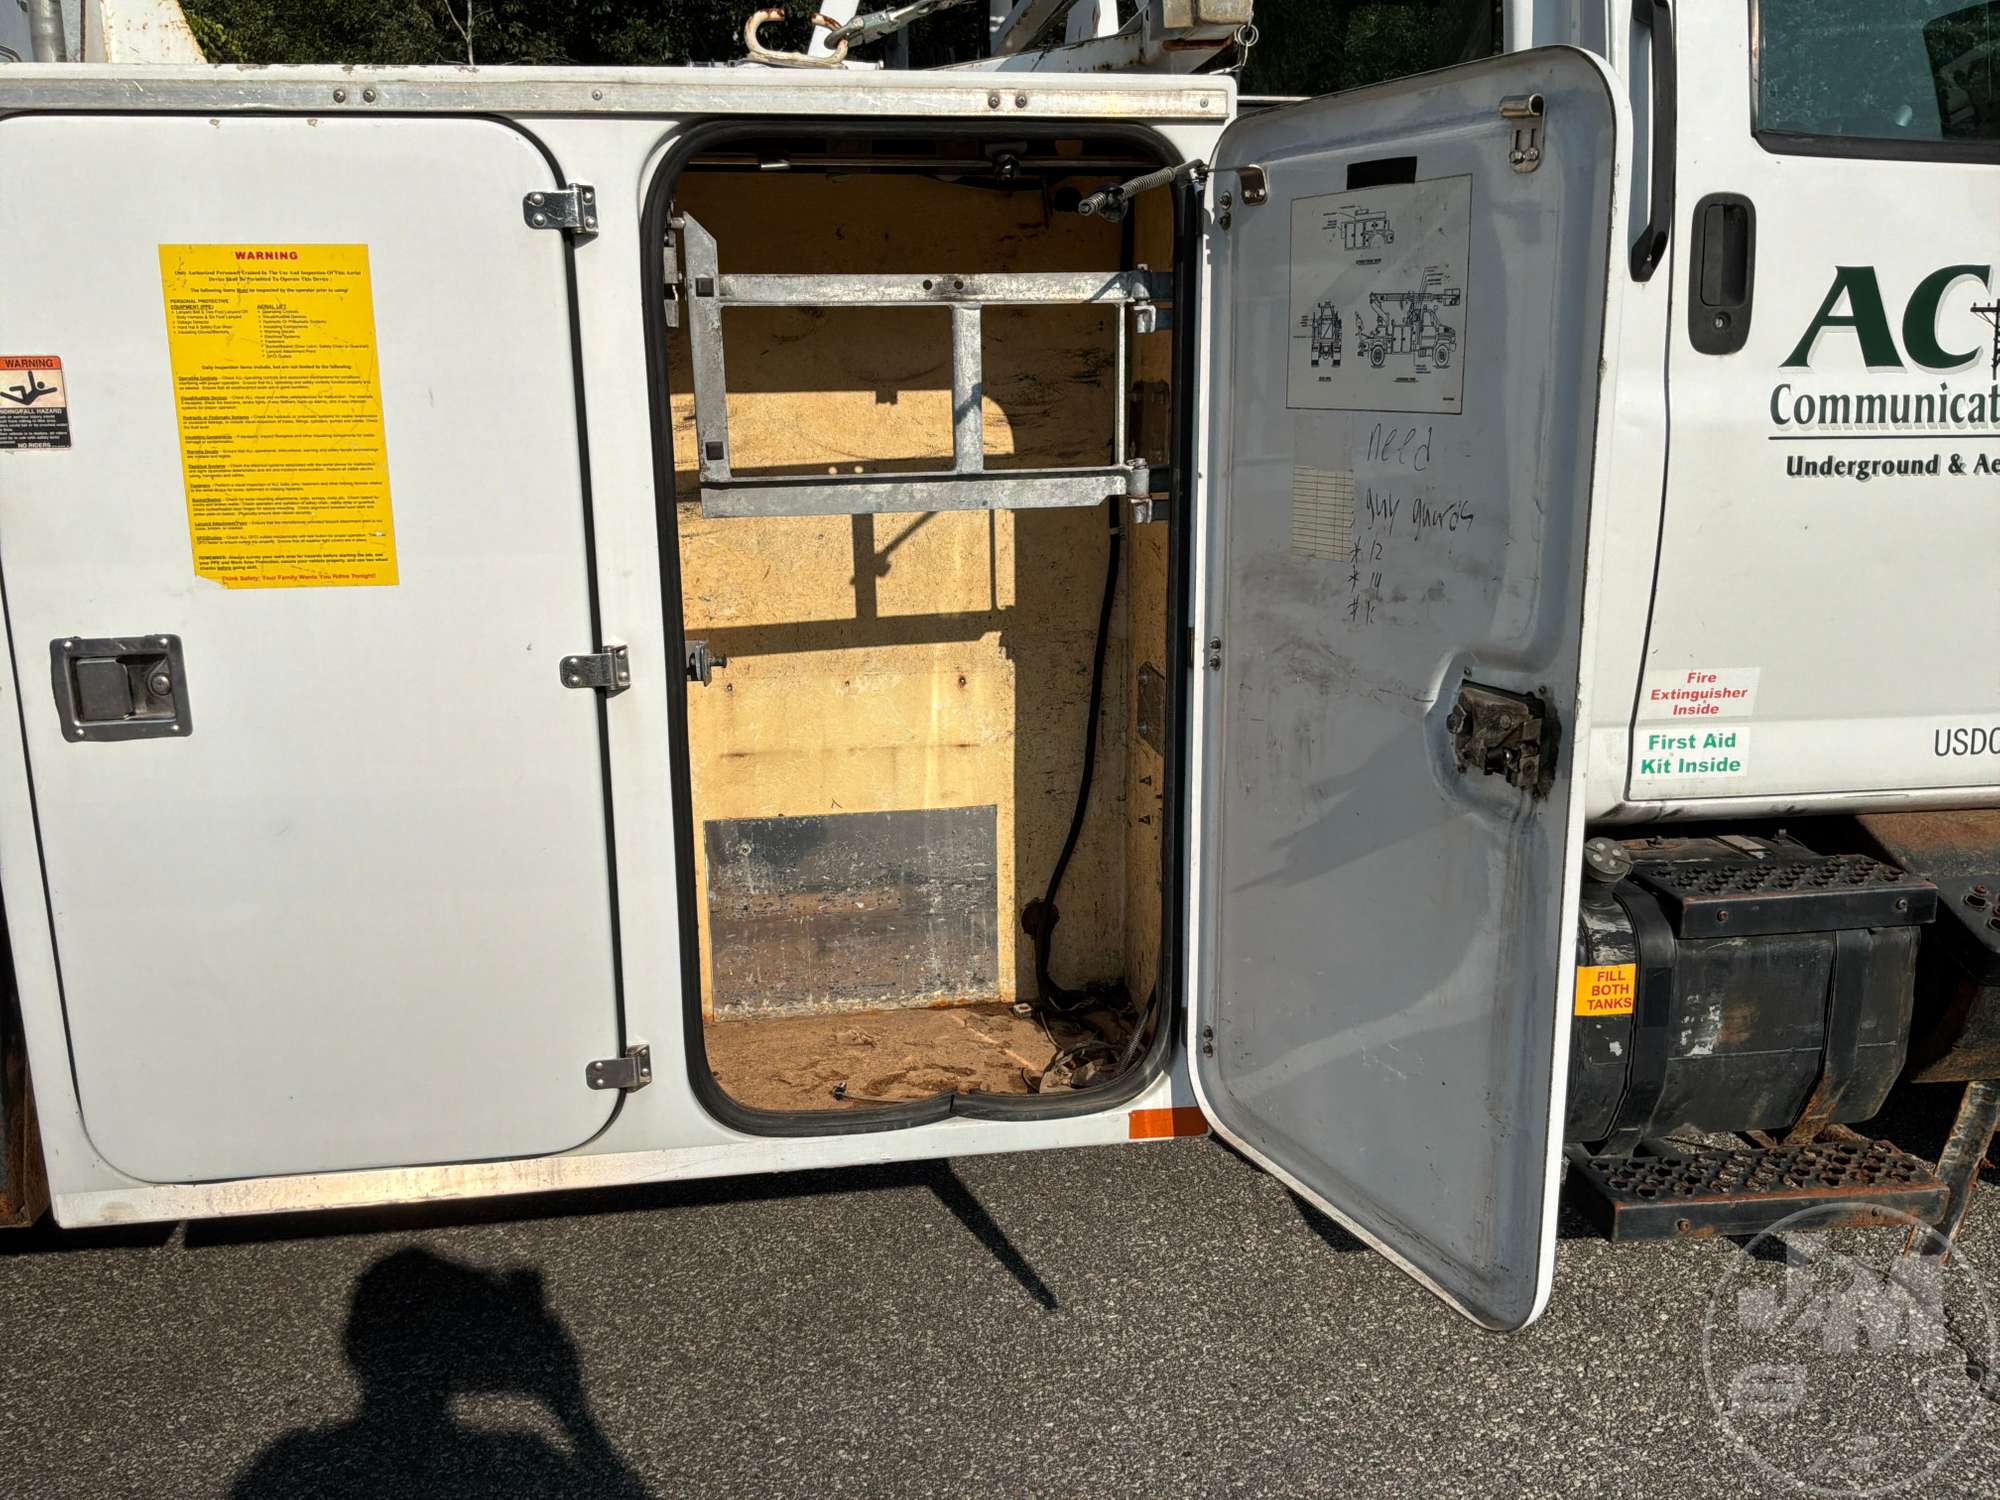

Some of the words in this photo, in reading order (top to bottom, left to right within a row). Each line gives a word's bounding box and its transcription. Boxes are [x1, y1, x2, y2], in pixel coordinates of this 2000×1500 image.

[235, 251, 298, 260] WARNING
[5, 360, 53, 368] WARNING
[1770, 382, 2000, 427] Communicat
[1786, 454, 1941, 481] Underground
[1948, 453, 1965, 475] &
[1973, 453, 2000, 475] Ae
[1687, 672, 1717, 684] Fire
[1650, 688, 1748, 702] Extinguisher
[1672, 704, 1720, 715] Inside
[1648, 734, 1696, 750] First
[1702, 732, 1736, 748] Aid
[1640, 758, 1672, 774] Kit
[1678, 757, 1741, 773] Inside
[1597, 971, 1626, 982] FILL
[1592, 984, 1630, 996] BOTH
[1587, 998, 1632, 1011] TANKS
